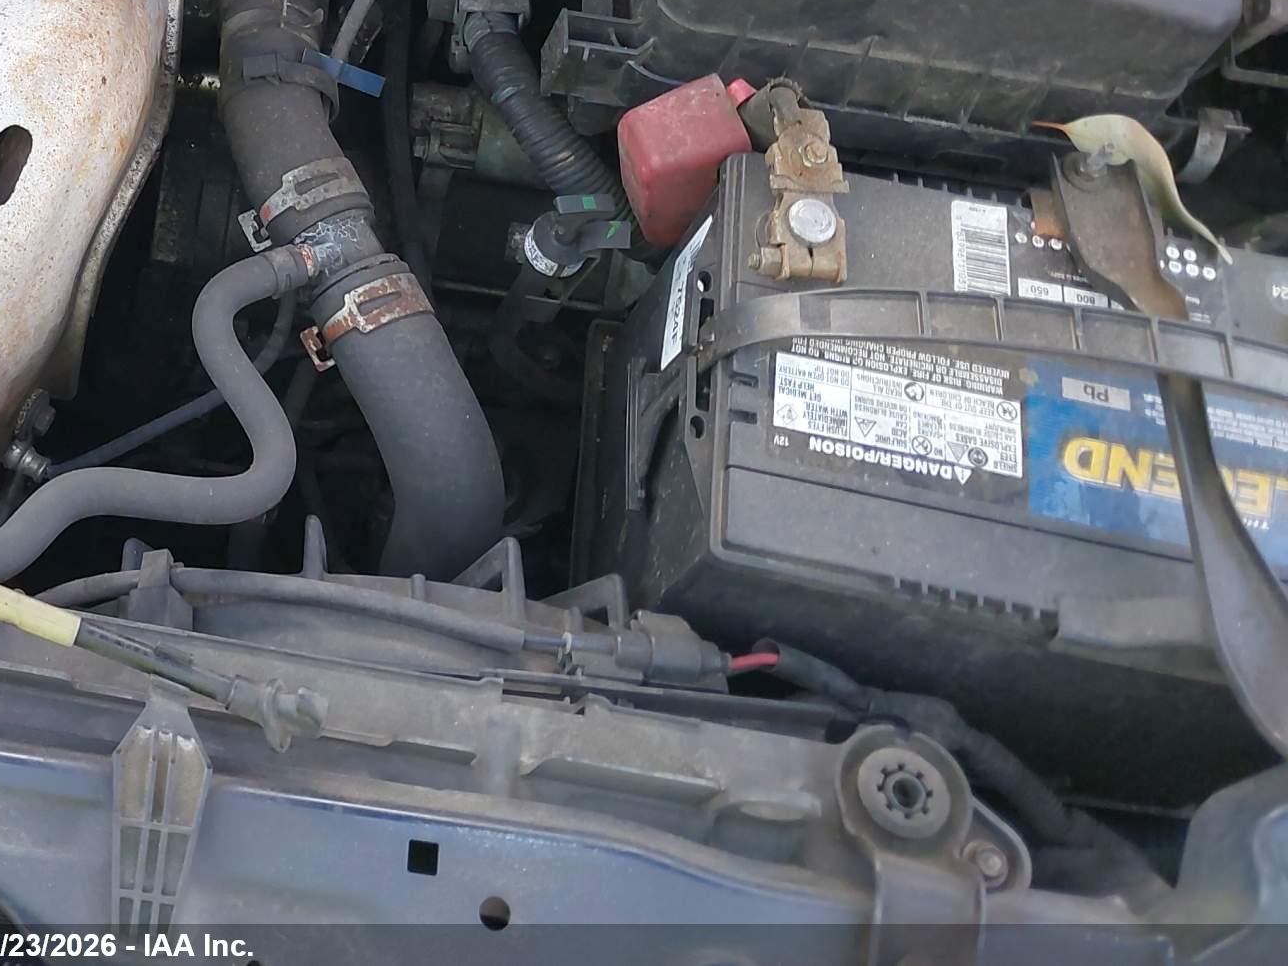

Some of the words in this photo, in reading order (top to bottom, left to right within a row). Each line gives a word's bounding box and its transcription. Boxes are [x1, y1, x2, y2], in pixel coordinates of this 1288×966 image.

[1080, 383, 1110, 403] Pb
[773, 434, 789, 446] 12V
[808, 435, 952, 479] DANGER/POISON
